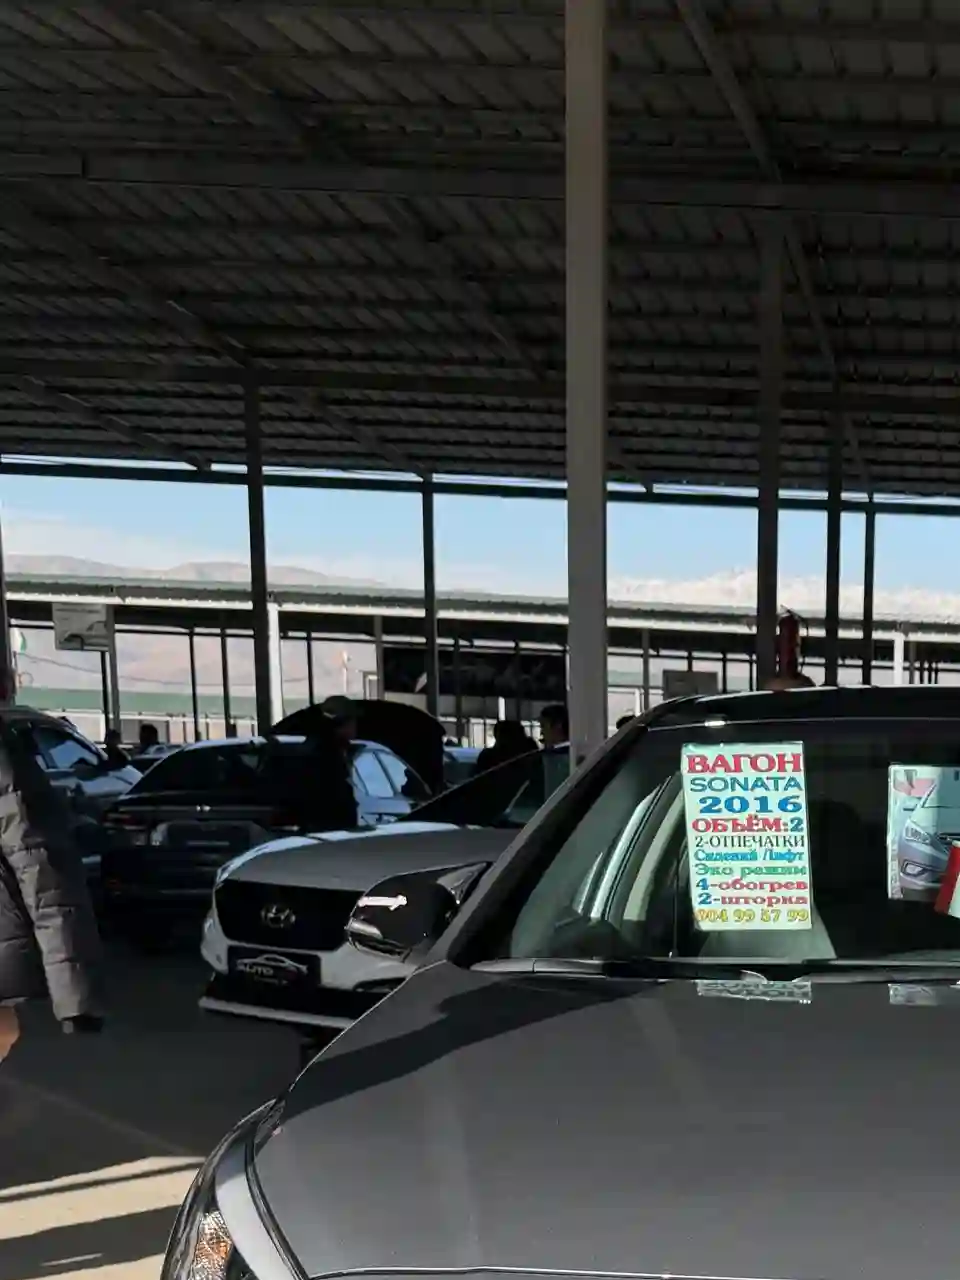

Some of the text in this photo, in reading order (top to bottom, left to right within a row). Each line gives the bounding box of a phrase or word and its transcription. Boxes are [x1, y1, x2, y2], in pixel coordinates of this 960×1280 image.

[686, 753, 802, 773] ВАГОН
[690, 777, 803, 792] SONATA
[699, 795, 803, 813] 2016
[695, 835, 805, 848] 2-ОТПЕЧАТКИ
[694, 864, 734, 876] Эко
[696, 877, 808, 892] 4-обогрев
[698, 893, 808, 907] 2-шторка
